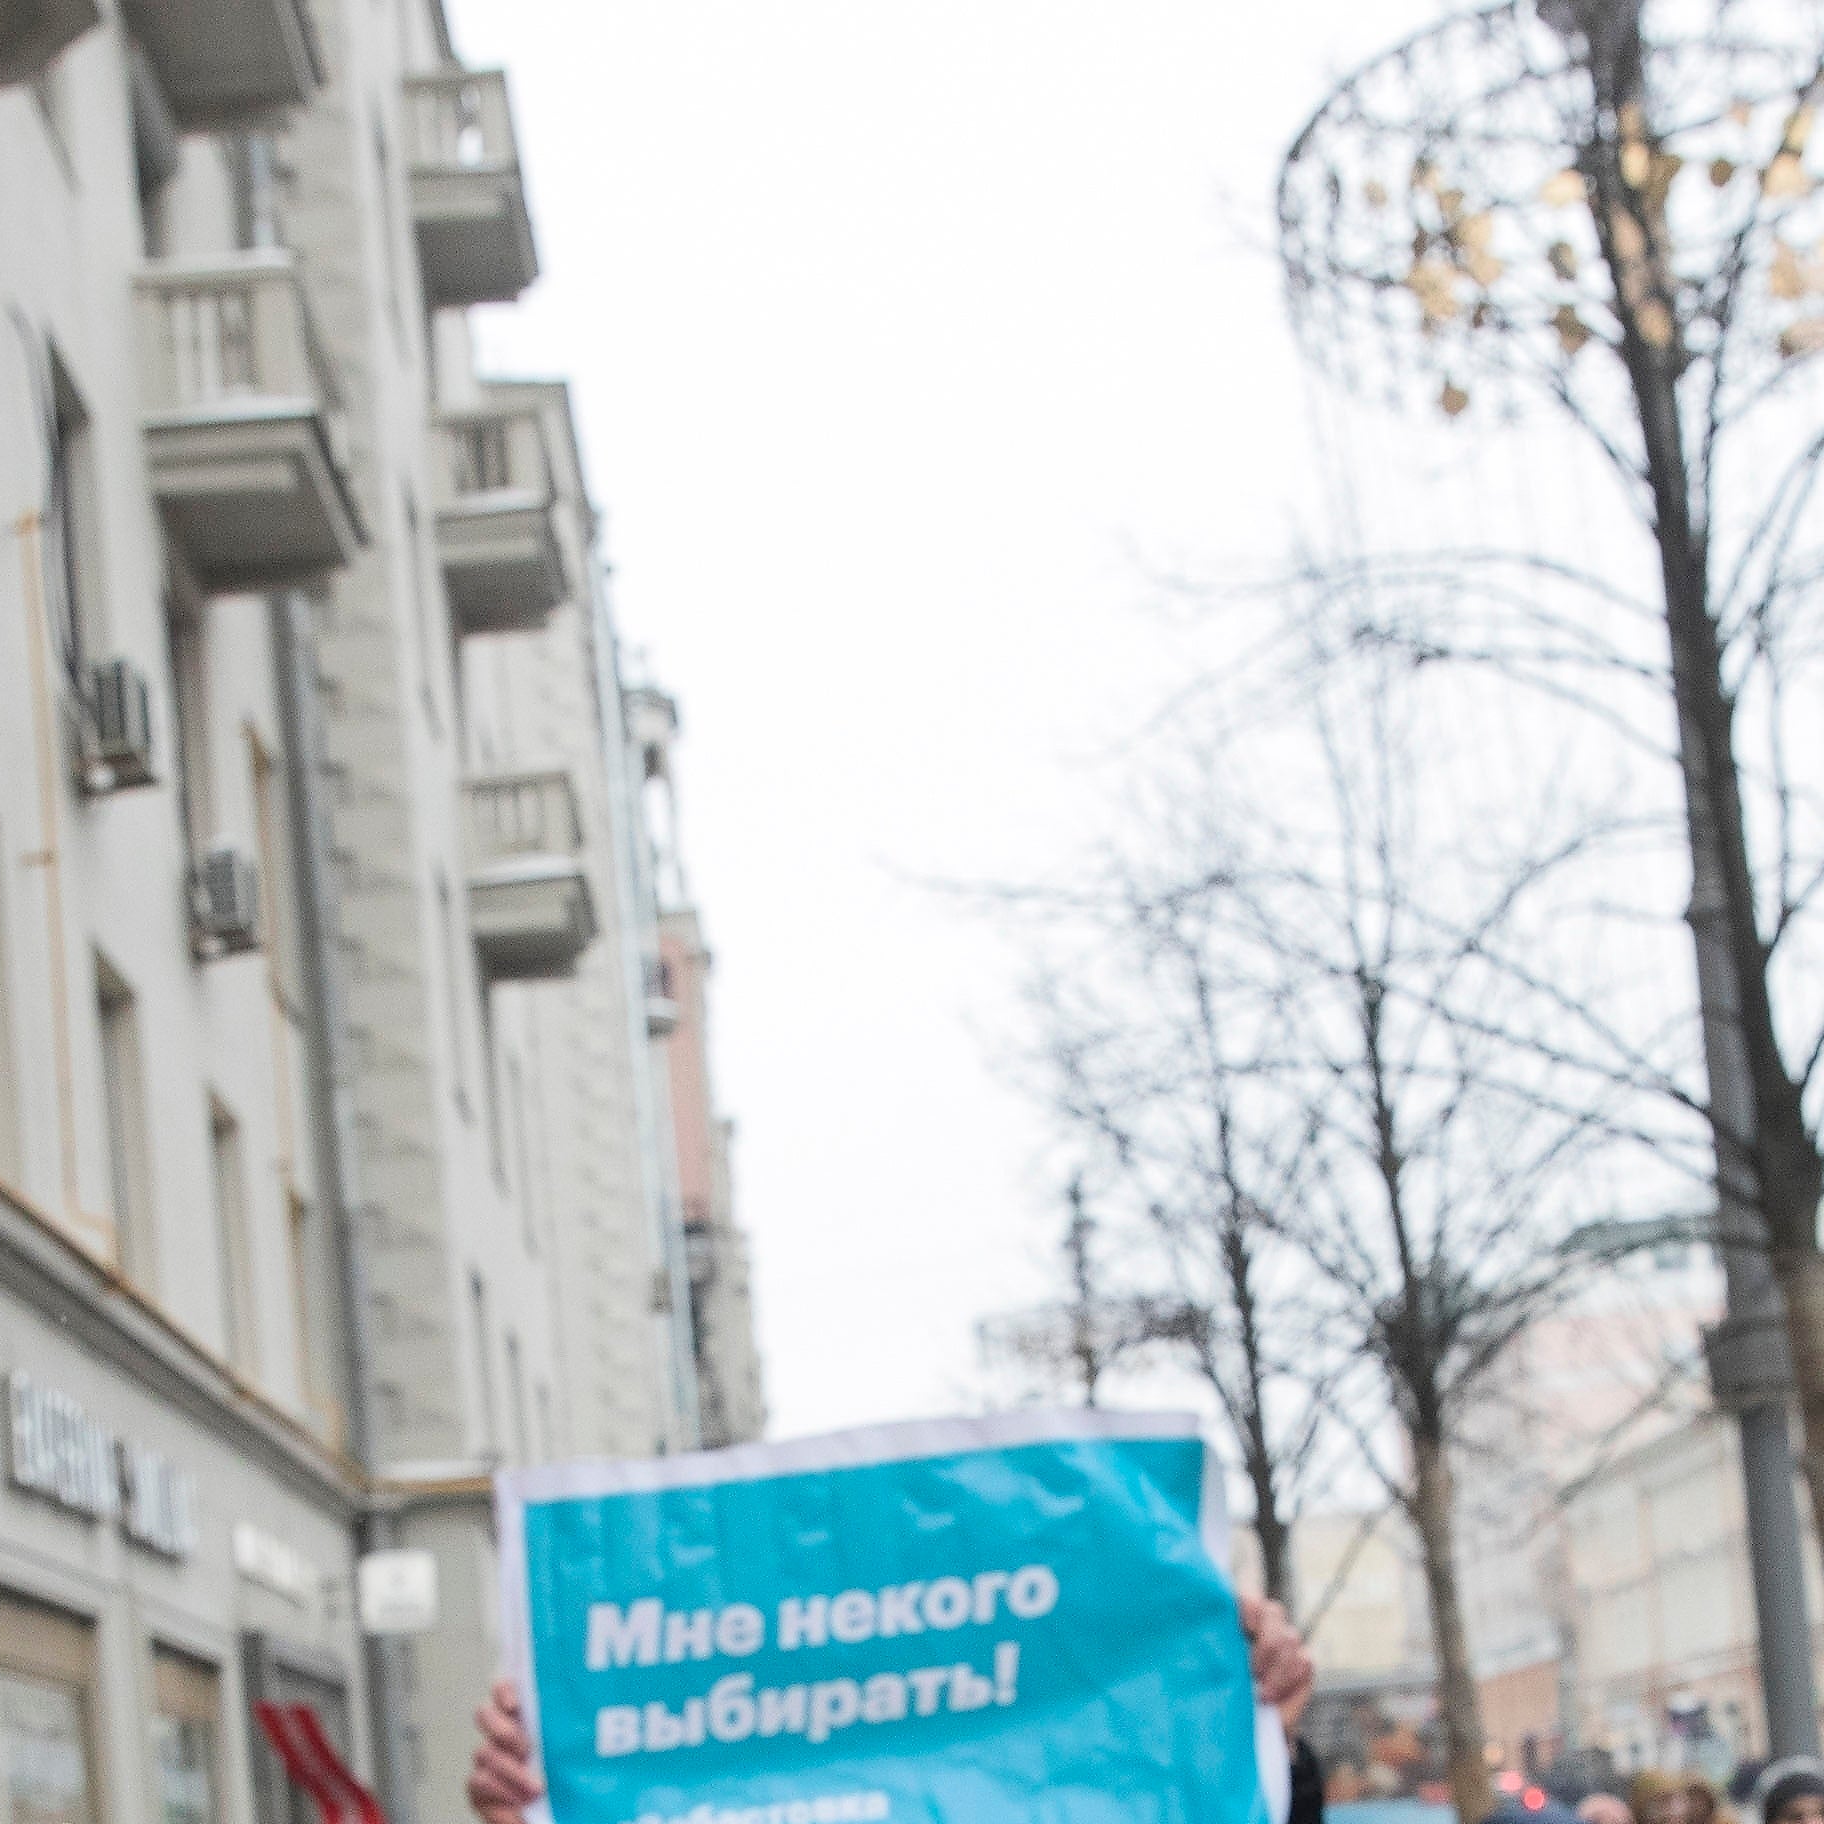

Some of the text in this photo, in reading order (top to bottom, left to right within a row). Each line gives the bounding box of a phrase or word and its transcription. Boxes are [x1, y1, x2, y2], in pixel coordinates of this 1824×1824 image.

[585, 1563, 1061, 1672] Мне некого
[595, 1640, 1020, 1759] выбирать!
